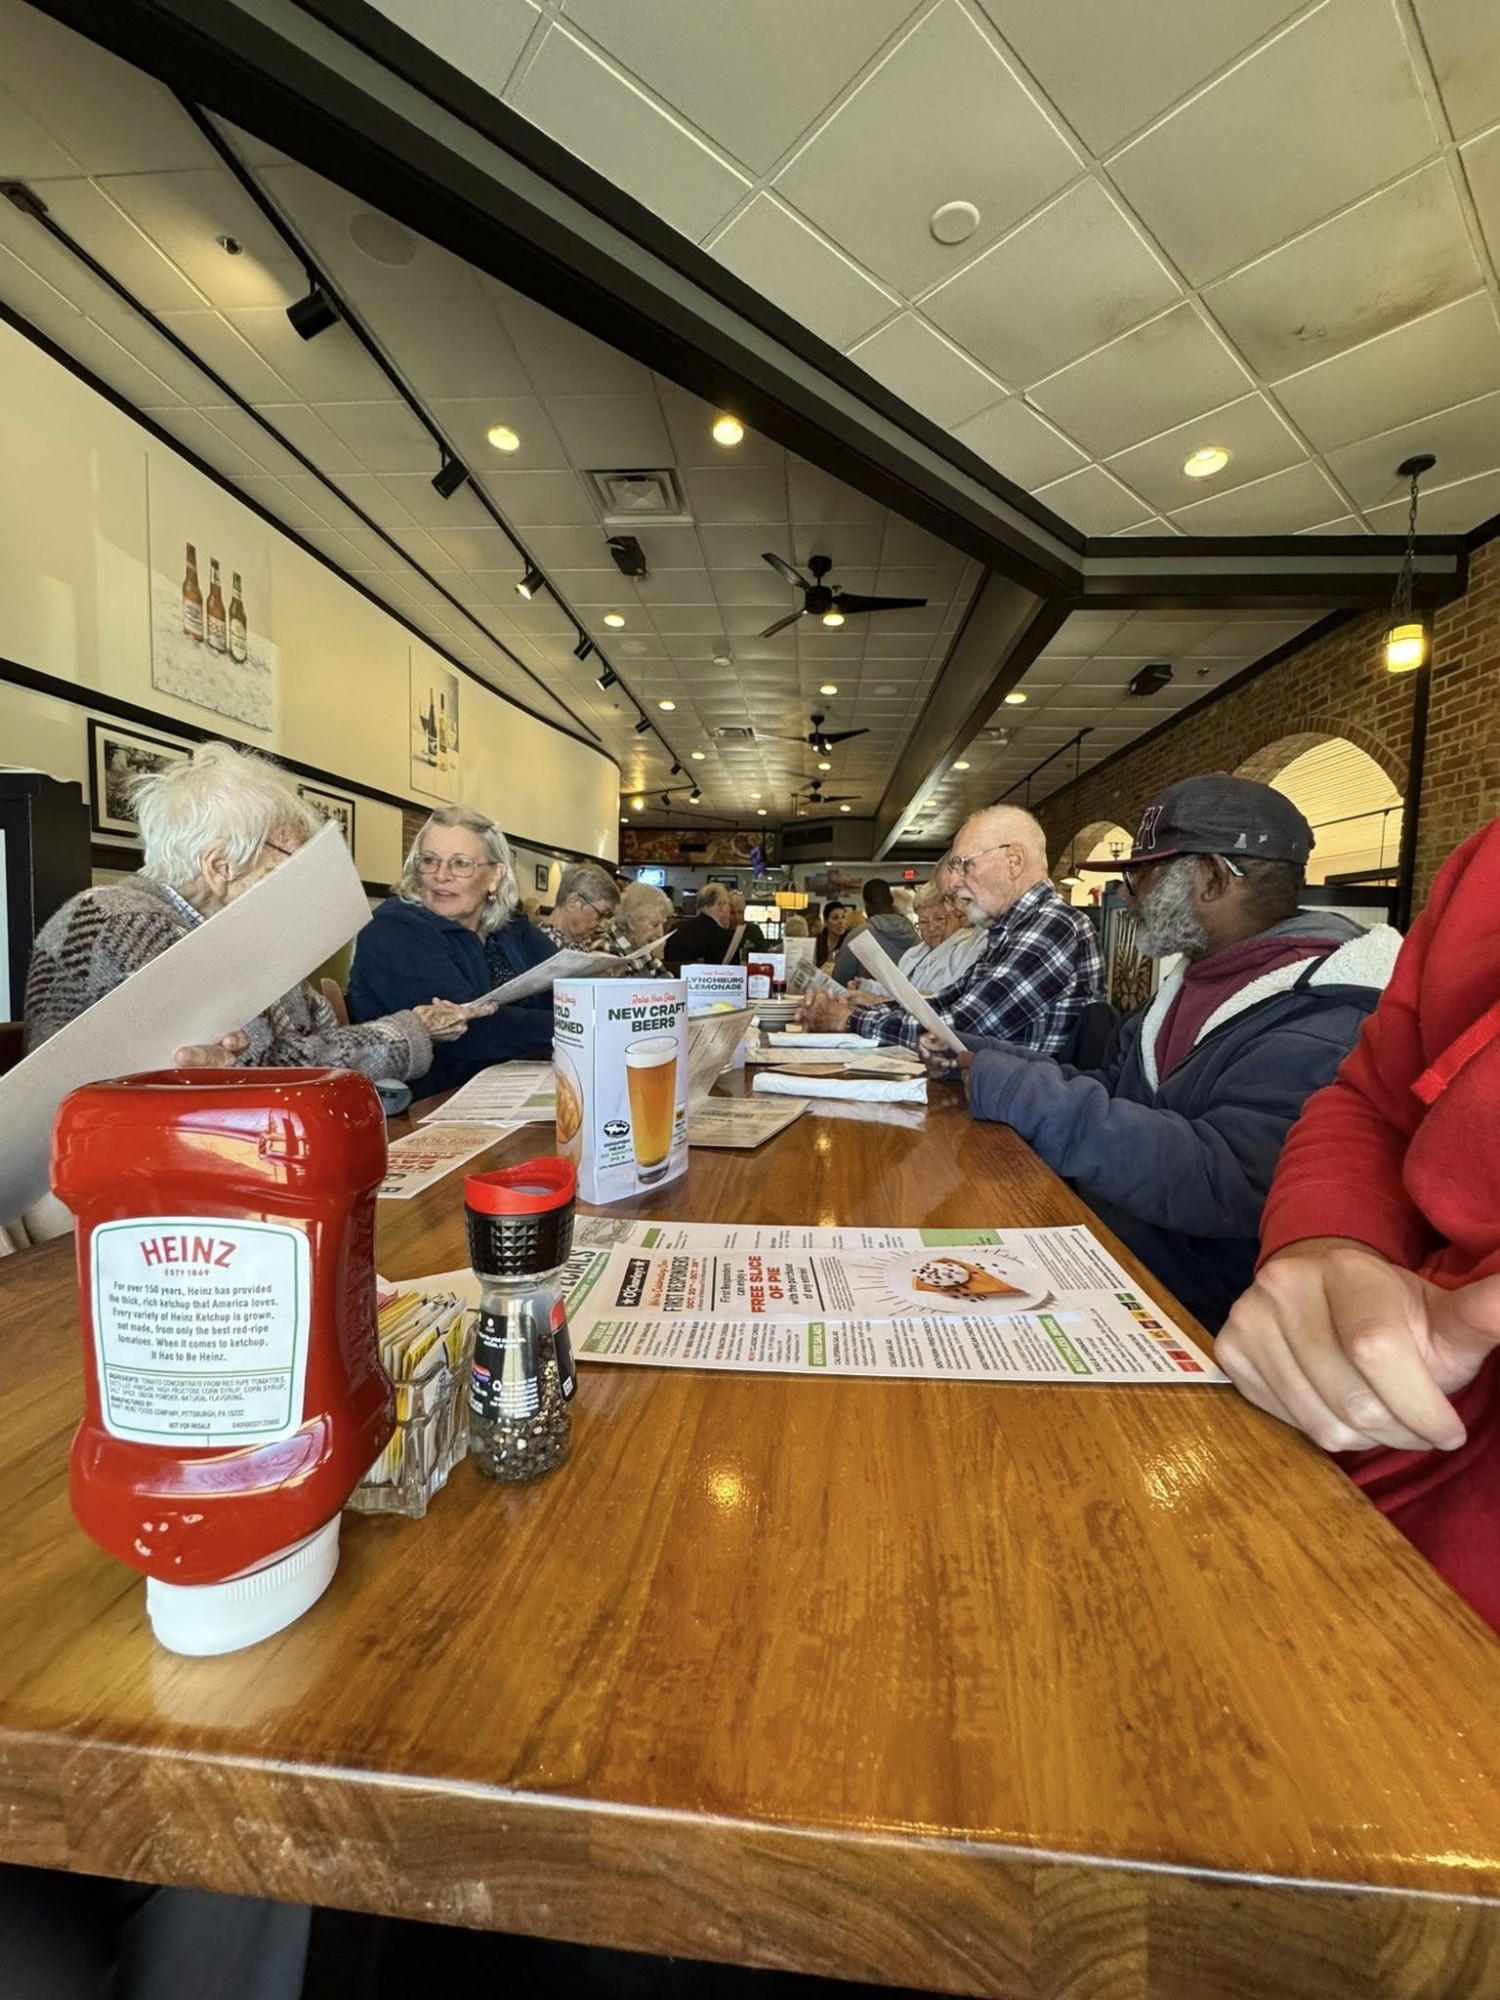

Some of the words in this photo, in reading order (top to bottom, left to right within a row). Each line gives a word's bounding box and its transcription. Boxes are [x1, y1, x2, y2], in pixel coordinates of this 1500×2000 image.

[686, 976, 744, 984] LYNCHBURG
[608, 1006, 647, 1021] NEW
[650, 1002, 685, 1016] CRAFT
[632, 1016, 676, 1033] BEERS
[140, 1236, 237, 1269] HEINZ
[667, 1256, 690, 1293] RESPONDERS
[721, 1263, 733, 1290] Responders
[748, 1255, 763, 1283] SLICE
[767, 1266, 781, 1283] PIE
[785, 1263, 798, 1284] purchase
[737, 1273, 748, 1286] enjoy
[113, 1281, 125, 1291] For
[127, 1284, 143, 1293] over
[145, 1284, 159, 1294] 150
[161, 1286, 185, 1296] years,
[187, 1286, 212, 1296] Heinz
[215, 1286, 230, 1295] has
[232, 1284, 272, 1296] provided
[720, 1290, 731, 1303] First
[737, 1287, 745, 1296] can
[769, 1285, 784, 1300] OF
[787, 1284, 798, 1293] the
[803, 1284, 813, 1293] any
[109, 1294, 120, 1303] the
[121, 1295, 141, 1306] thick,
[143, 1297, 158, 1307] rich
[160, 1298, 191, 1310] ketchup
[193, 1299, 210, 1309] that
[212, 1299, 249, 1309] America
[251, 1298, 279, 1307] loves.
[663, 1294, 684, 1312] FIRST
[750, 1286, 766, 1313] FREE
[788, 1294, 799, 1305] with
[112, 1307, 131, 1319] Every
[133, 1311, 159, 1322] variety
[160, 1312, 169, 1321] of
[170, 1312, 193, 1322] Heinz
[195, 1312, 231, 1323] Ketchup
[233, 1312, 242, 1321] is
[243, 1312, 275, 1322] grown,
[118, 1322, 129, 1331] not
[130, 1323, 154, 1334] made,
[155, 1324, 174, 1334] from
[176, 1326, 193, 1337] only
[195, 1326, 209, 1335] the
[212, 1325, 231, 1335] best
[232, 1323, 269, 1335] red-ripe
[1043, 1317, 1062, 1337] DRINKS
[118, 1333, 155, 1346] tomatoes.
[156, 1337, 179, 1347] When
[181, 1339, 187, 1348] it
[188, 1340, 217, 1348] comes
[219, 1339, 228, 1348] to
[151, 1351, 157, 1360] It
[159, 1351, 174, 1361] Has
[176, 1352, 184, 1361] to
[186, 1352, 197, 1361] Be
[199, 1352, 227, 1361] Heinz.
[1056, 1336, 1087, 1372] BOTTOMLESS
